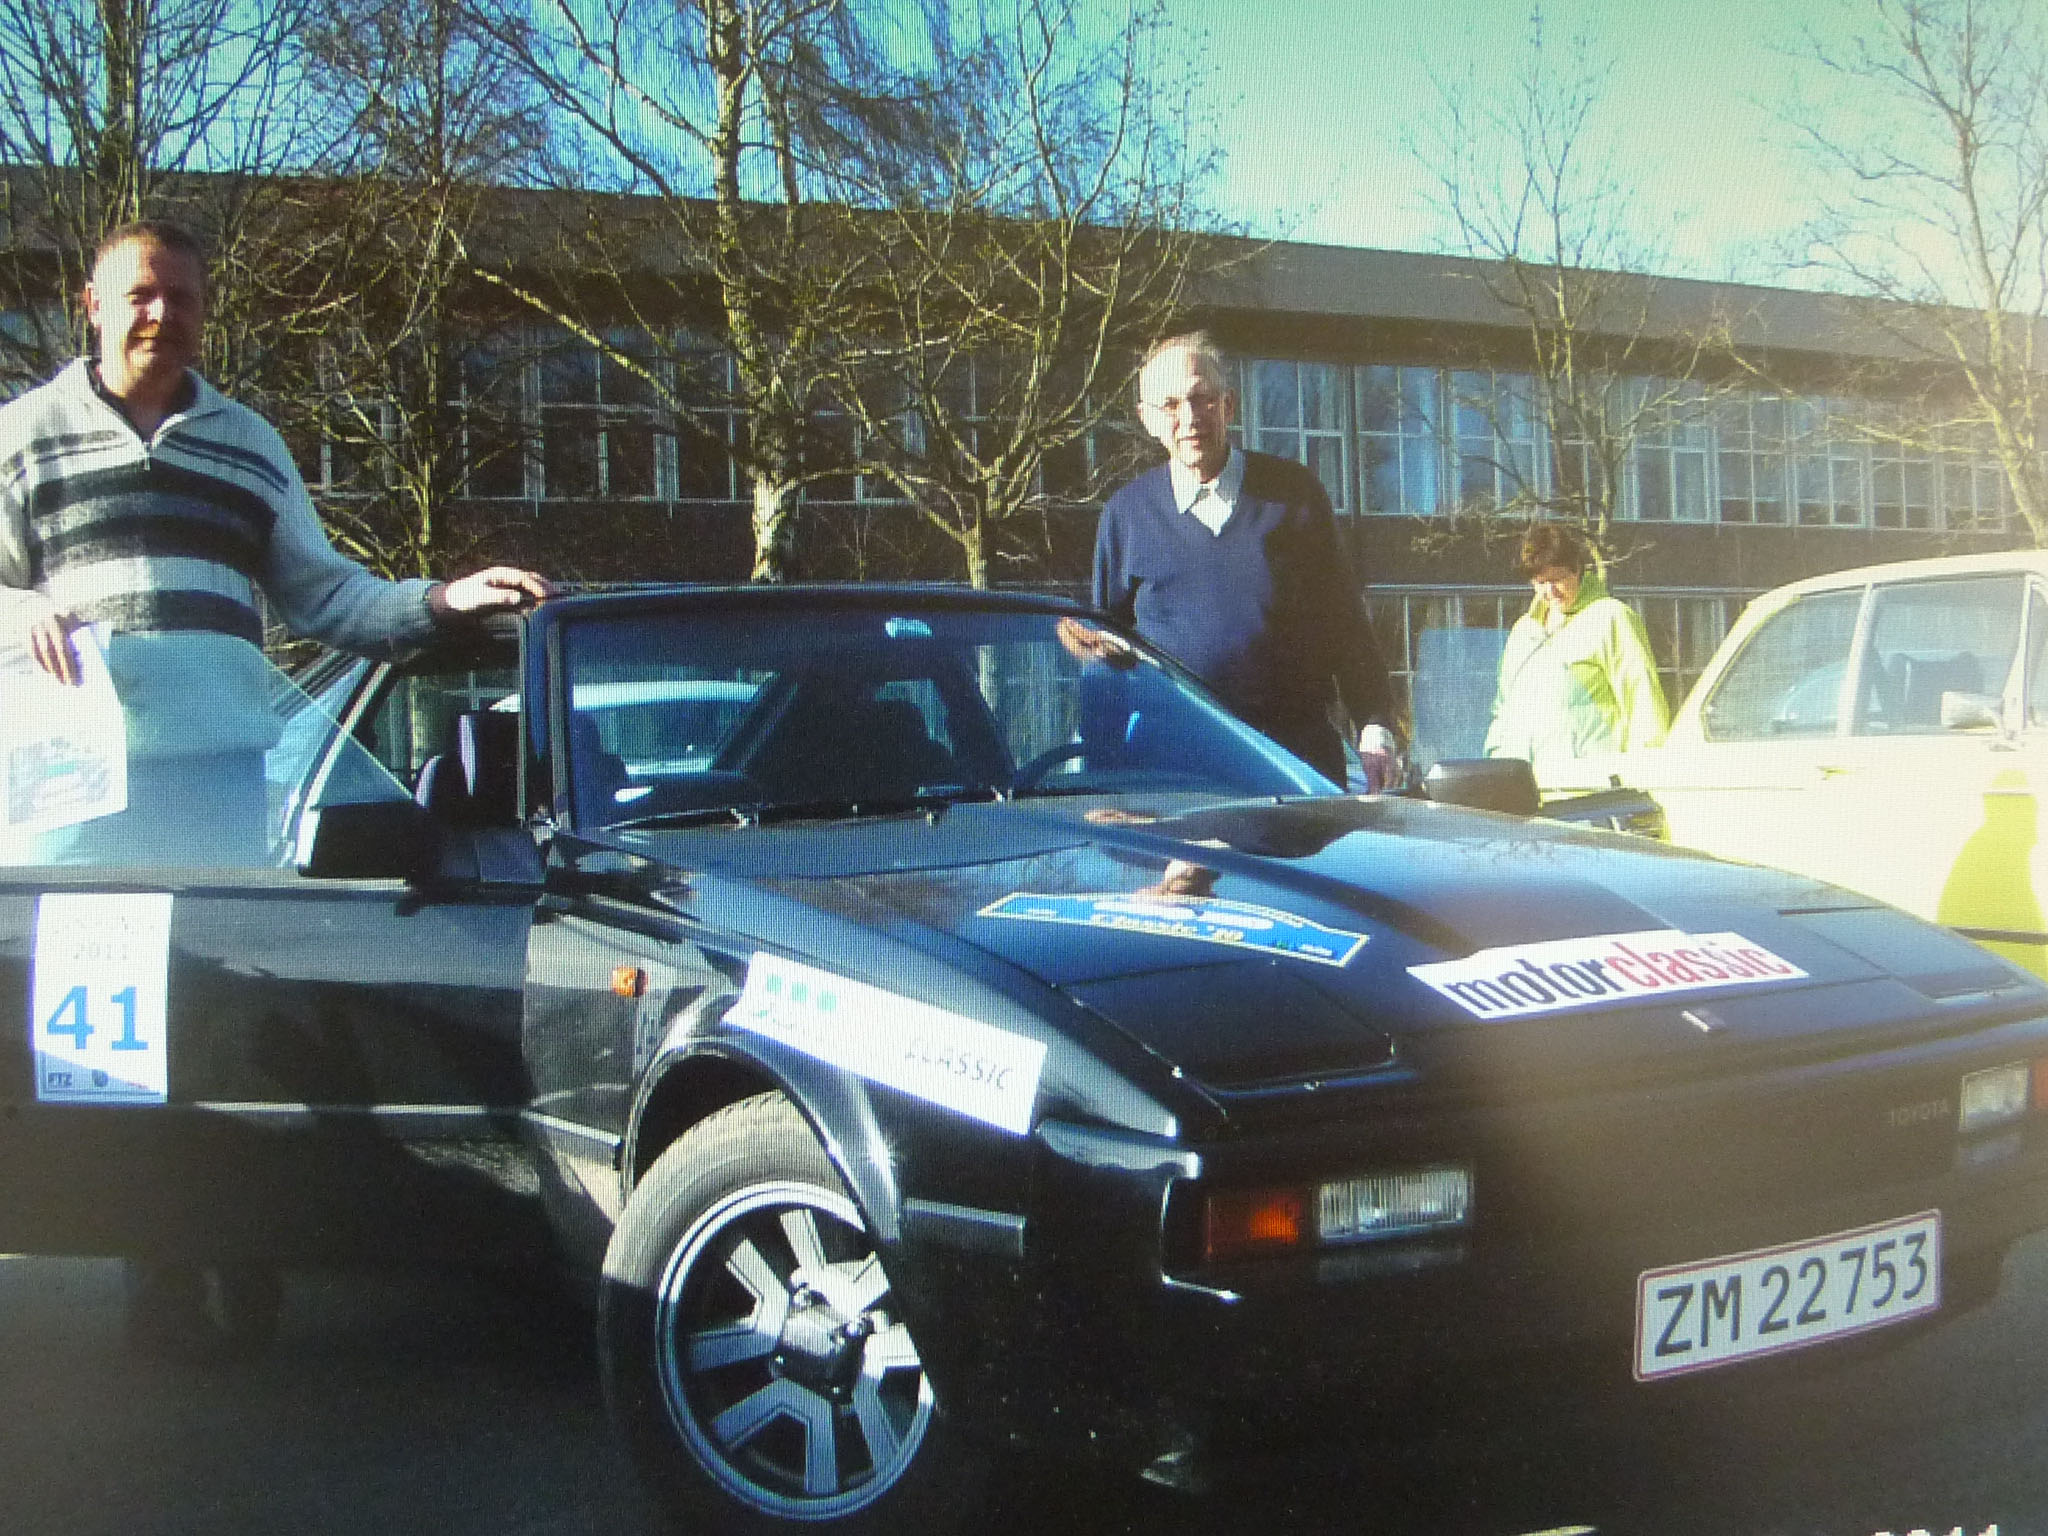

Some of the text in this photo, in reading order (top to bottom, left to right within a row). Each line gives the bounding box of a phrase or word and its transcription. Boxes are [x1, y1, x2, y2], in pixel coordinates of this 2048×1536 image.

[1444, 941, 1793, 1012] motorclassic
[47, 985, 149, 1051] 41
[48, 1072, 73, 1087] FTZ
[904, 1037, 1015, 1092] CLASSIC
[1884, 1097, 1951, 1128] TOYOTA
[1654, 1230, 1928, 1357] ZM 22 753
